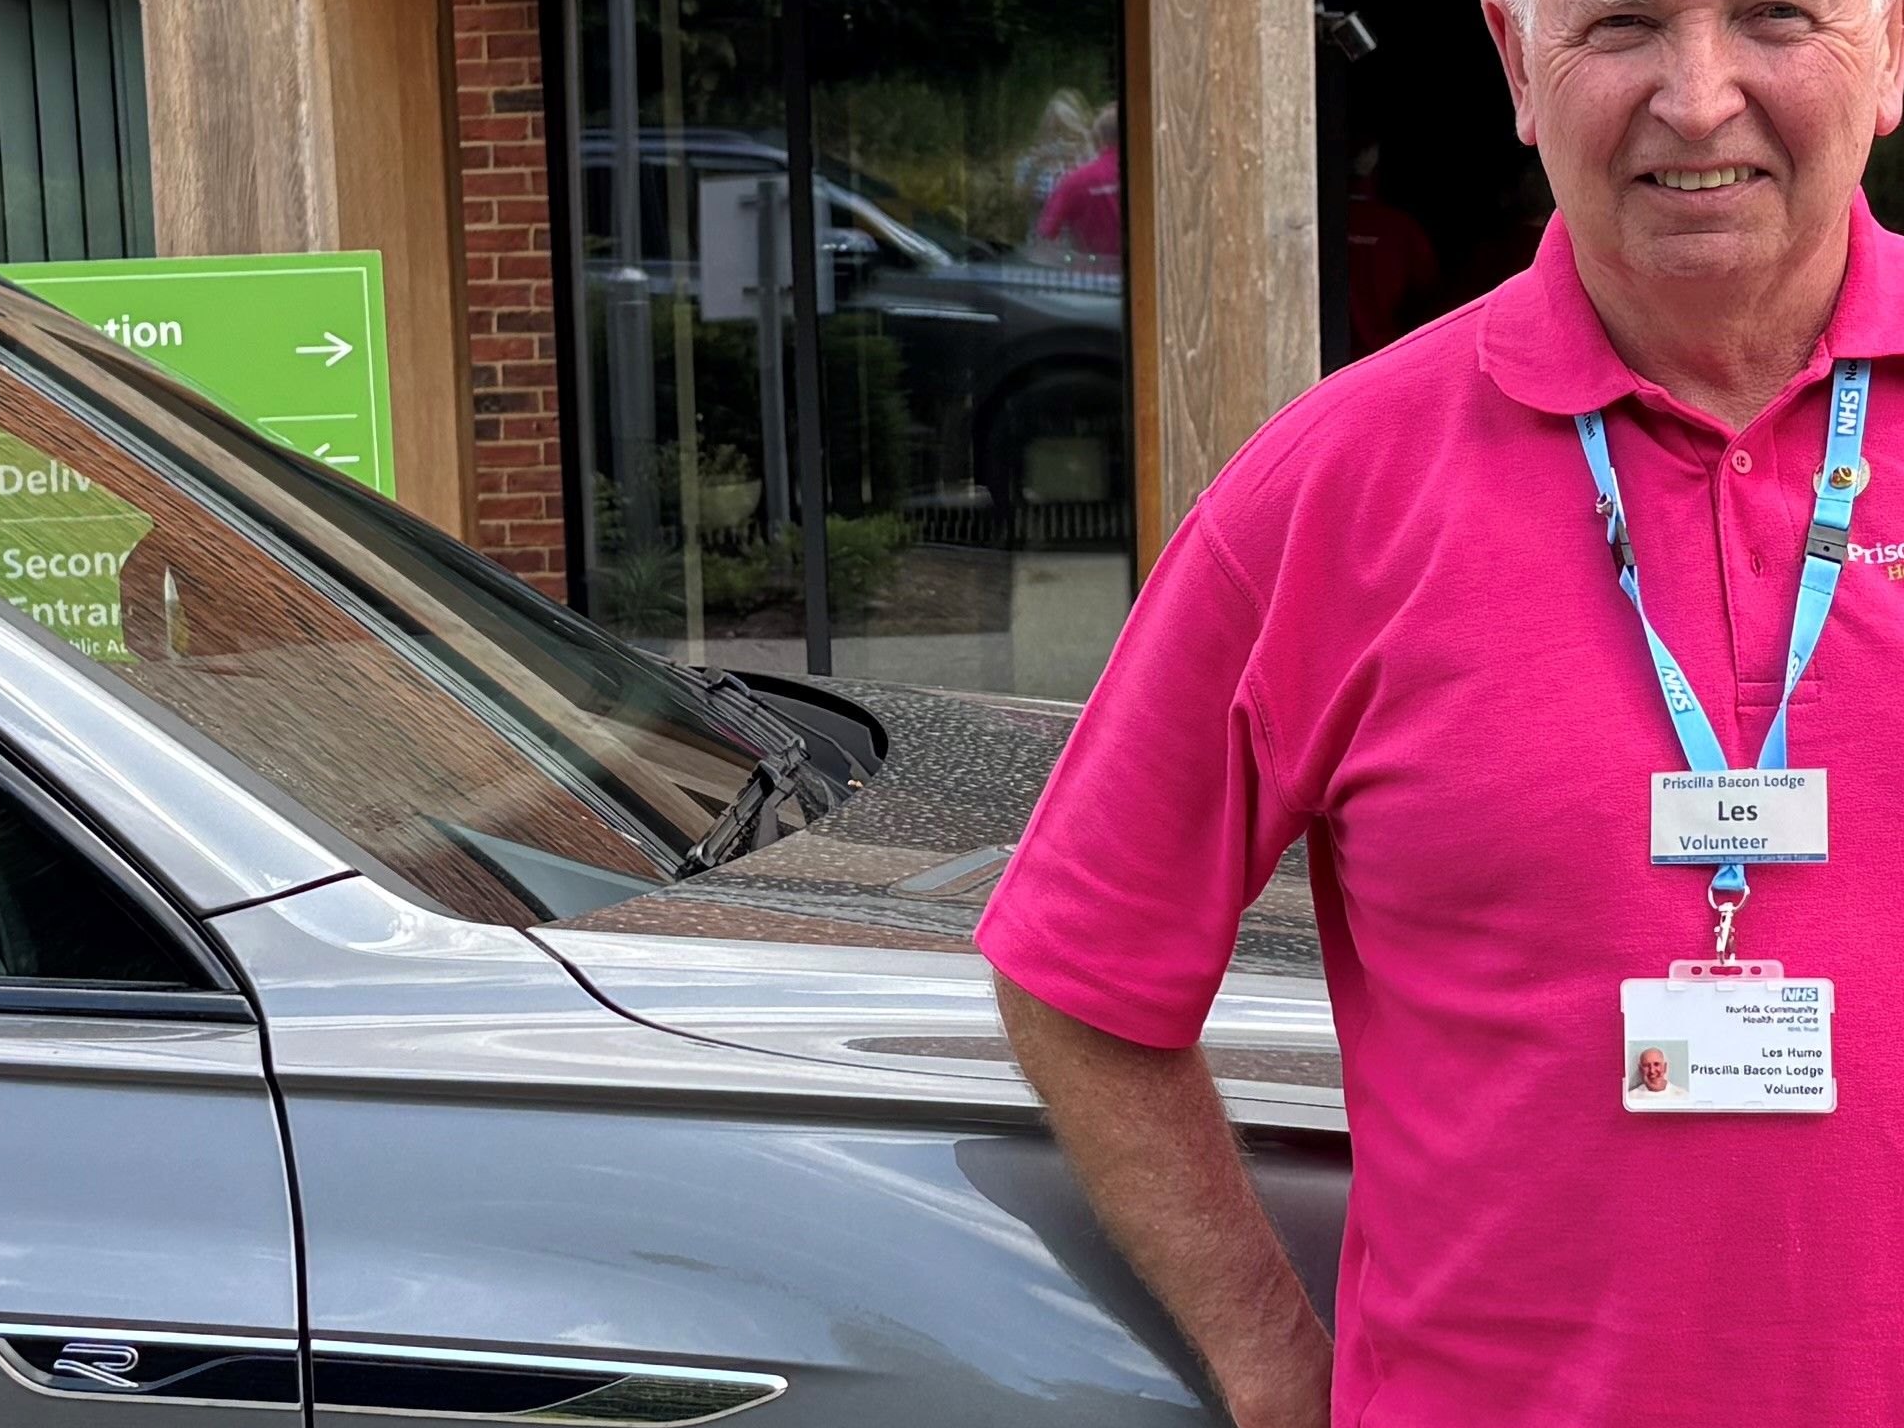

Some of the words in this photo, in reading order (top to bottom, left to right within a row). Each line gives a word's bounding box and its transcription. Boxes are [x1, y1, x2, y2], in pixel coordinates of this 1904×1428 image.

[94, 314, 183, 348] tion
[1836, 389, 1861, 436] NHS
[1659, 665, 1694, 713] NHS
[1662, 776, 1714, 790] Priscilla
[1718, 776, 1760, 788] Bacon
[1764, 775, 1806, 790] Lodge
[1718, 801, 1758, 822] Les
[1679, 835, 1768, 851] Volunteer
[1782, 987, 1818, 1002] NHS
[1691, 1064, 1740, 1075] Priscilla
[1743, 1064, 1783, 1076] Bacon
[1786, 1065, 1825, 1079] Lodge
[1764, 1084, 1825, 1095] Volunteer
